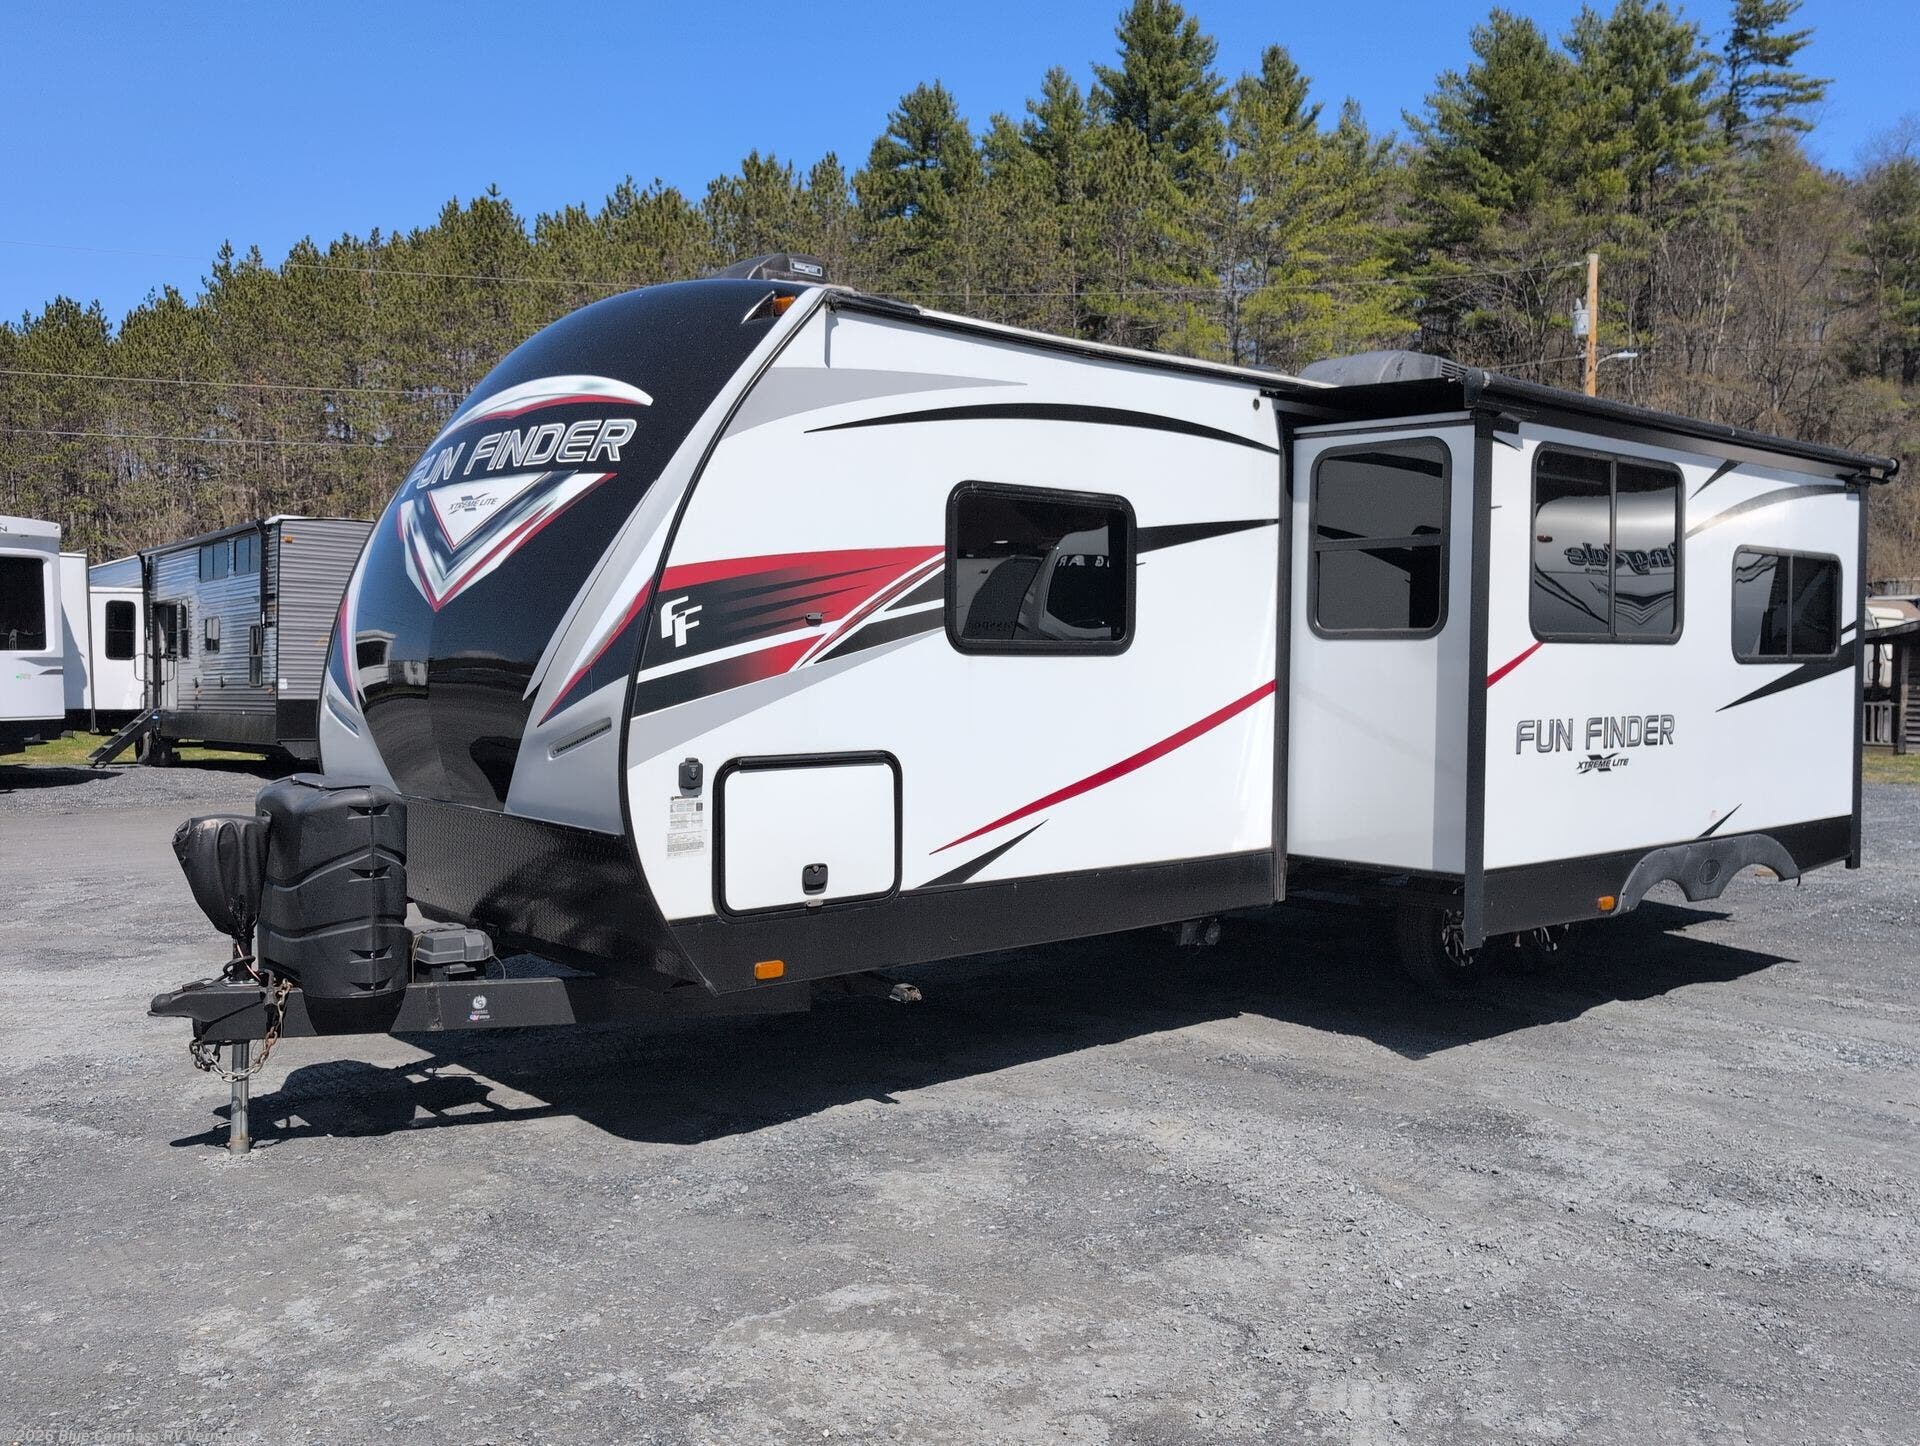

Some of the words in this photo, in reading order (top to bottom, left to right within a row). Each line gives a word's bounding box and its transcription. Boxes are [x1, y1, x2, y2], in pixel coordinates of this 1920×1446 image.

[401, 442, 466, 497] FUN
[463, 418, 637, 476] FINDER
[661, 595, 703, 648] FF
[1516, 718, 1574, 755] FUN
[1585, 714, 1675, 750] FINDER
[1576, 757, 1612, 771] XTREME
[1612, 757, 1629, 767] LITE
